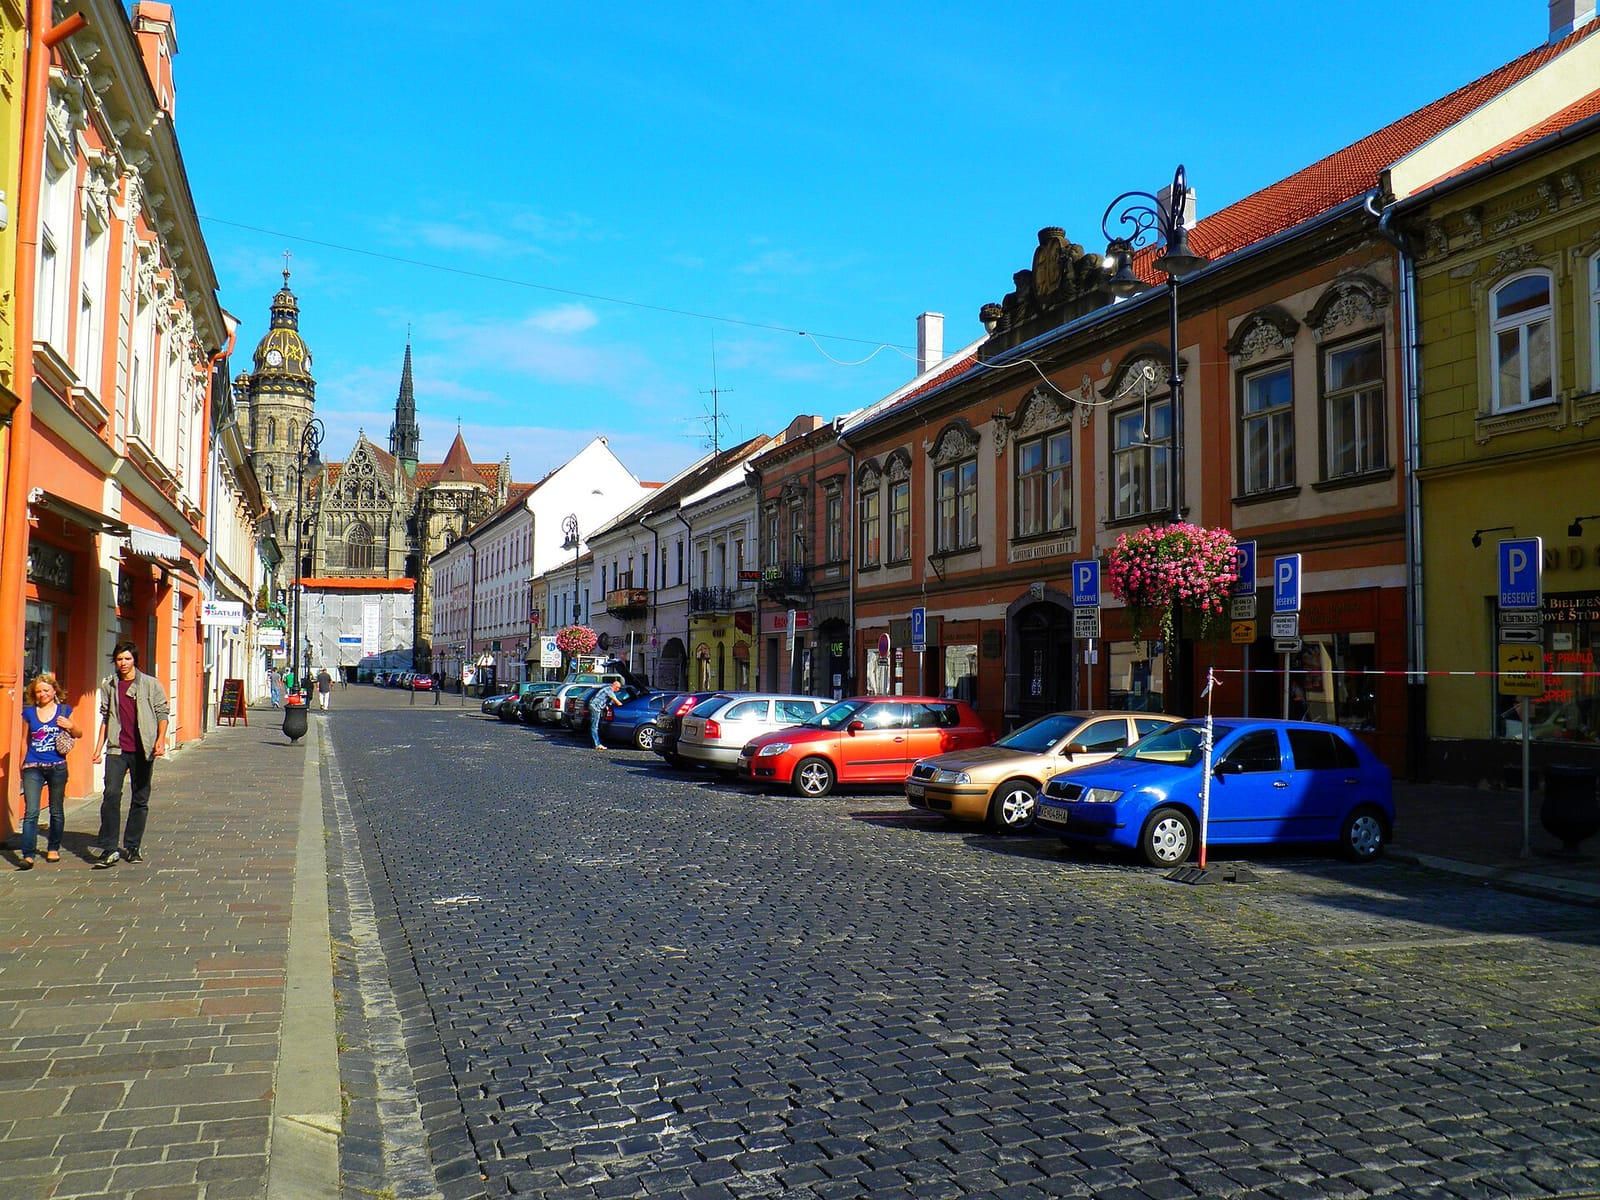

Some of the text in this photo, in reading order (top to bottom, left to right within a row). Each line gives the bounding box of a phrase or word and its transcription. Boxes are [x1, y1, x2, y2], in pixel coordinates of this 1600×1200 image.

[1080, 567, 1091, 591] P
[1279, 563, 1292, 595] P
[1509, 549, 1527, 585] P
[1502, 590, 1535, 604] RÉSERVÉ
[915, 612, 922, 633] P
